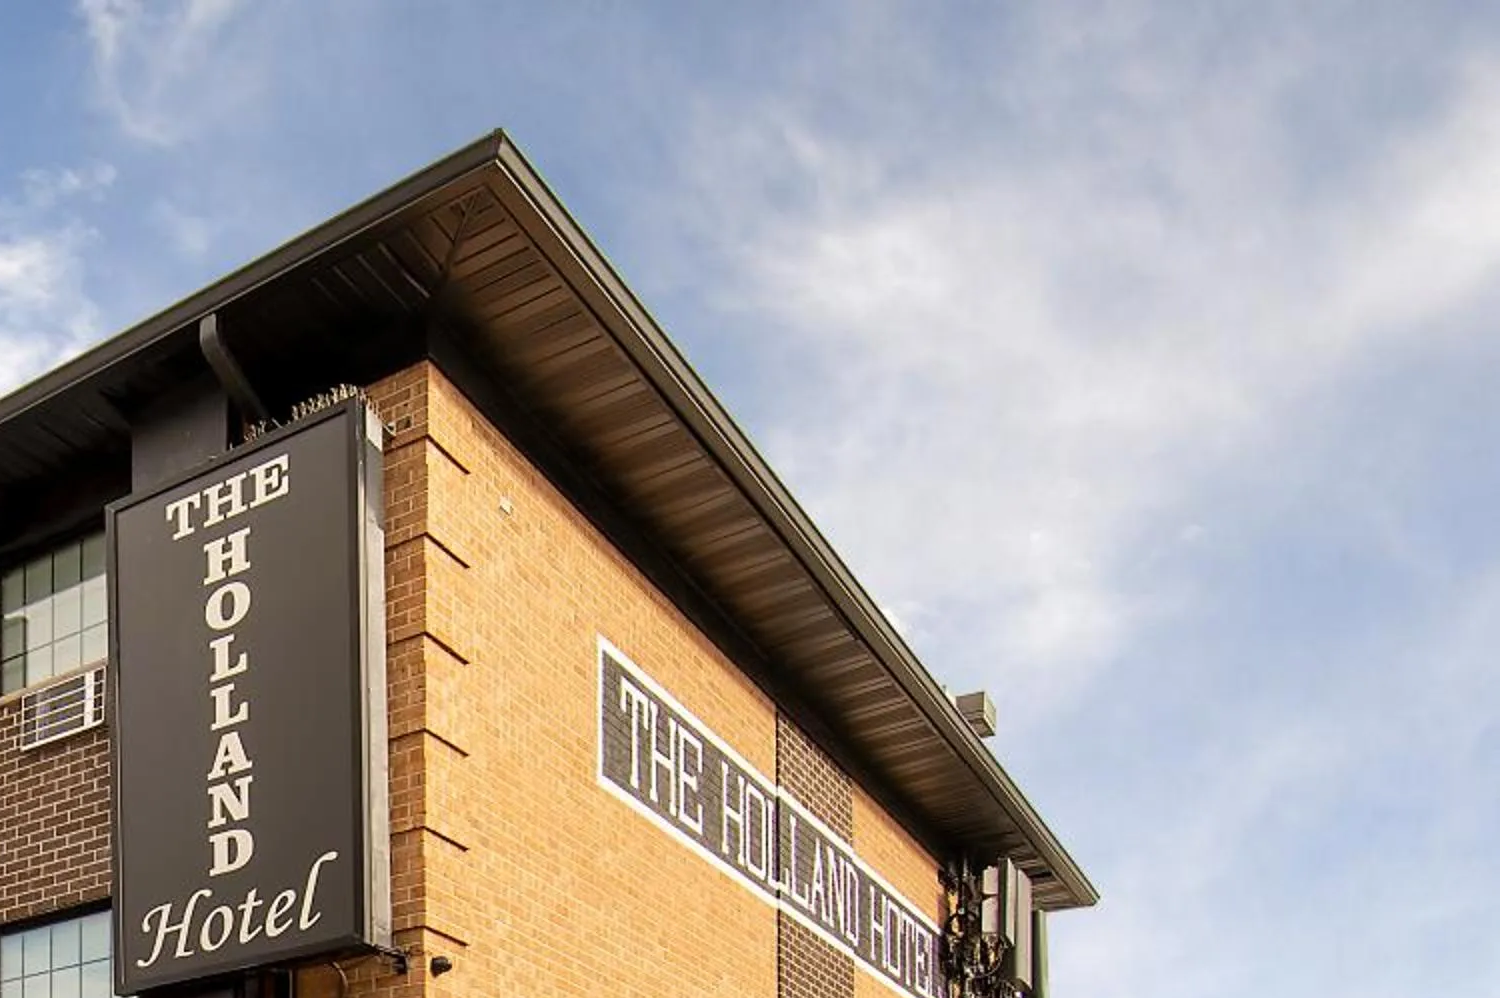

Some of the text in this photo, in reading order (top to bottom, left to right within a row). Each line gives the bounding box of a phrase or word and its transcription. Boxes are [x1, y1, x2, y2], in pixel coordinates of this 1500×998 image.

[166, 454, 290, 541] THE
[203, 526, 255, 877] HOLLAND
[619, 675, 703, 836] THE
[720, 759, 860, 948] HOLLAND
[137, 851, 338, 968] Hotel
